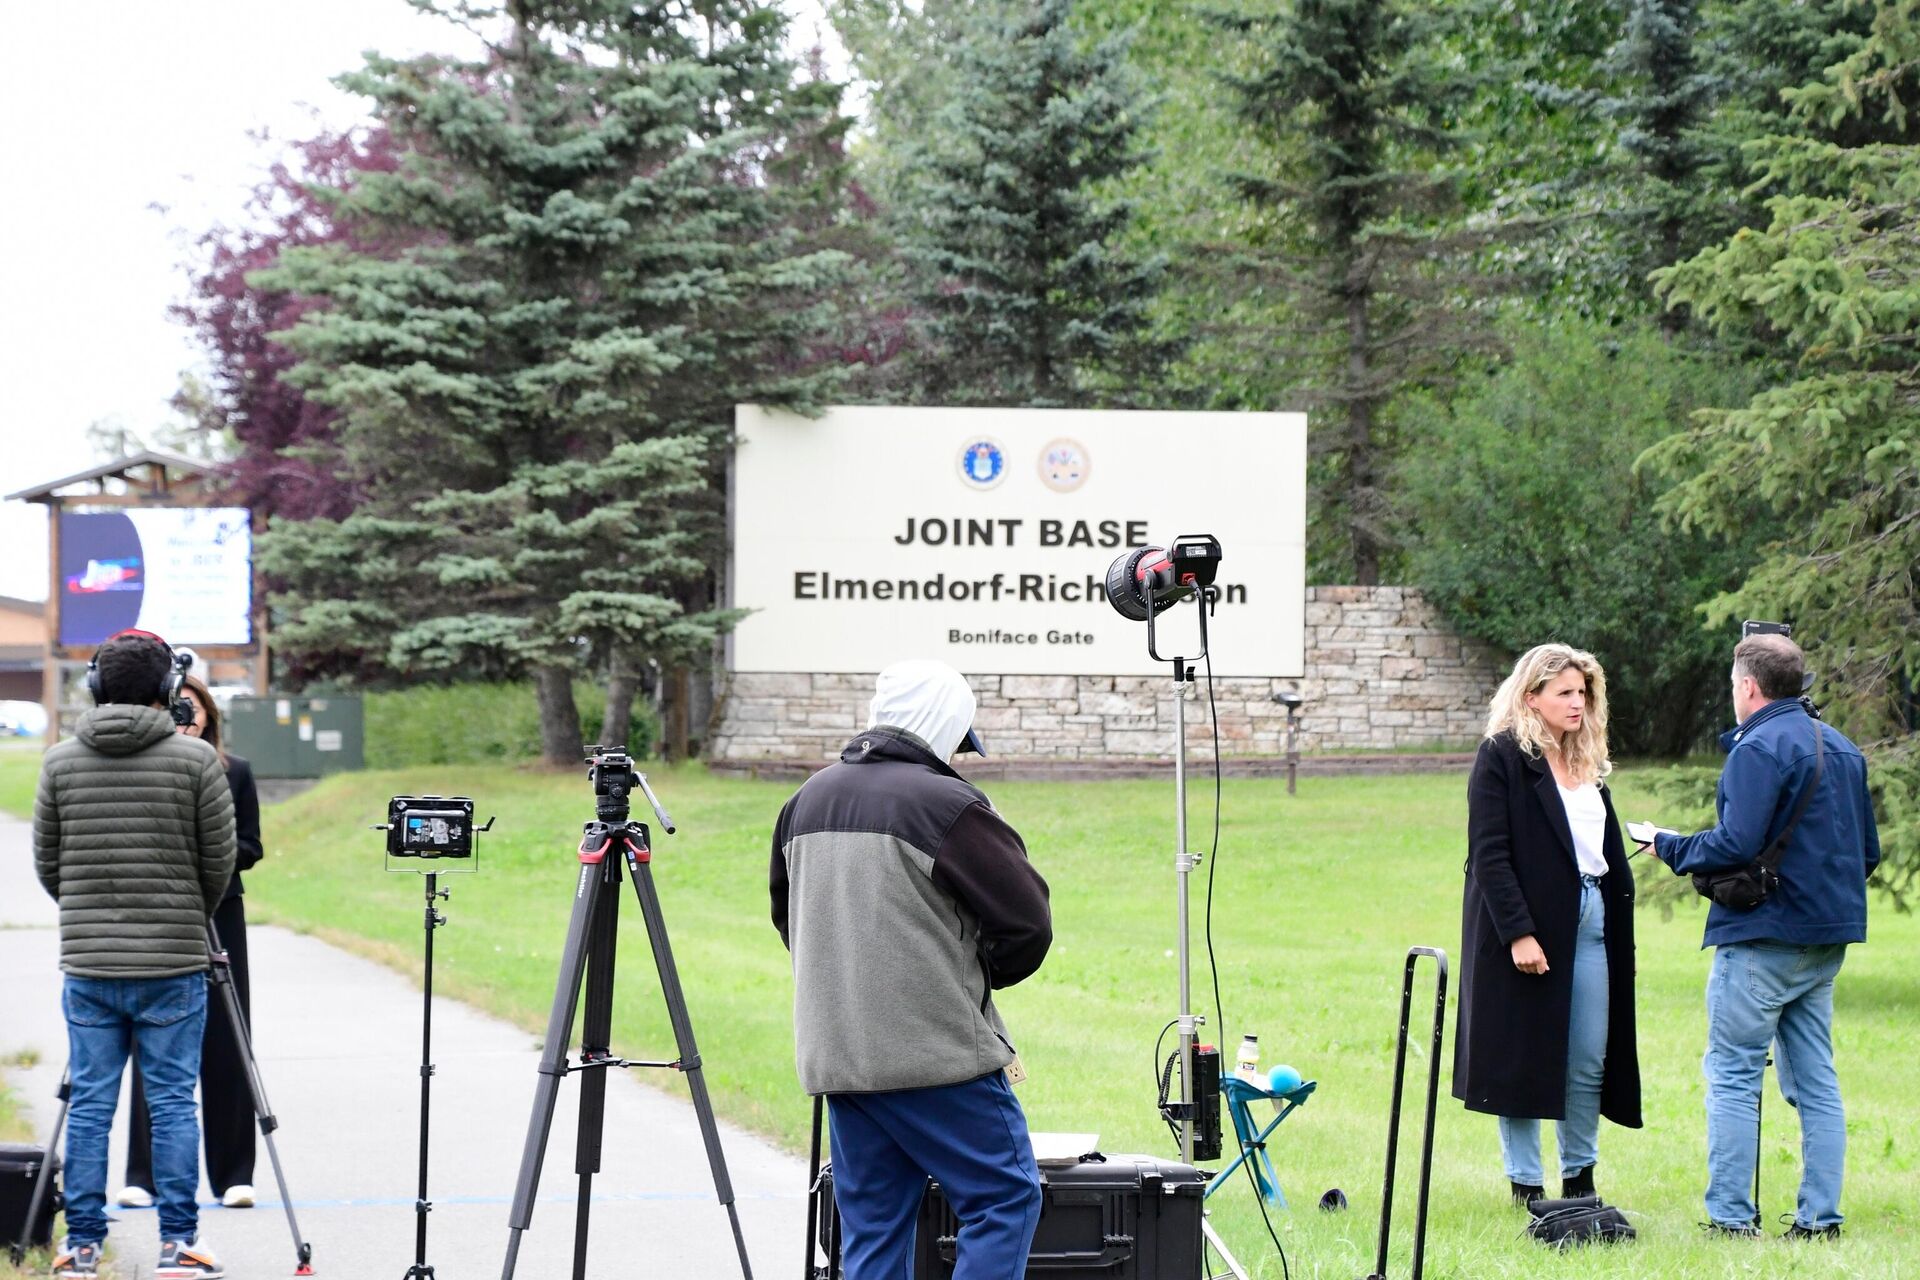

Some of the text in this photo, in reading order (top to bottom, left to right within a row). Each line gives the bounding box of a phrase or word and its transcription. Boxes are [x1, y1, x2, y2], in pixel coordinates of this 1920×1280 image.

[893, 517, 1149, 548] JOINT BASE
[793, 571, 1248, 604] Elmendorf-Richon
[948, 628, 1095, 646] Boniface Gate
